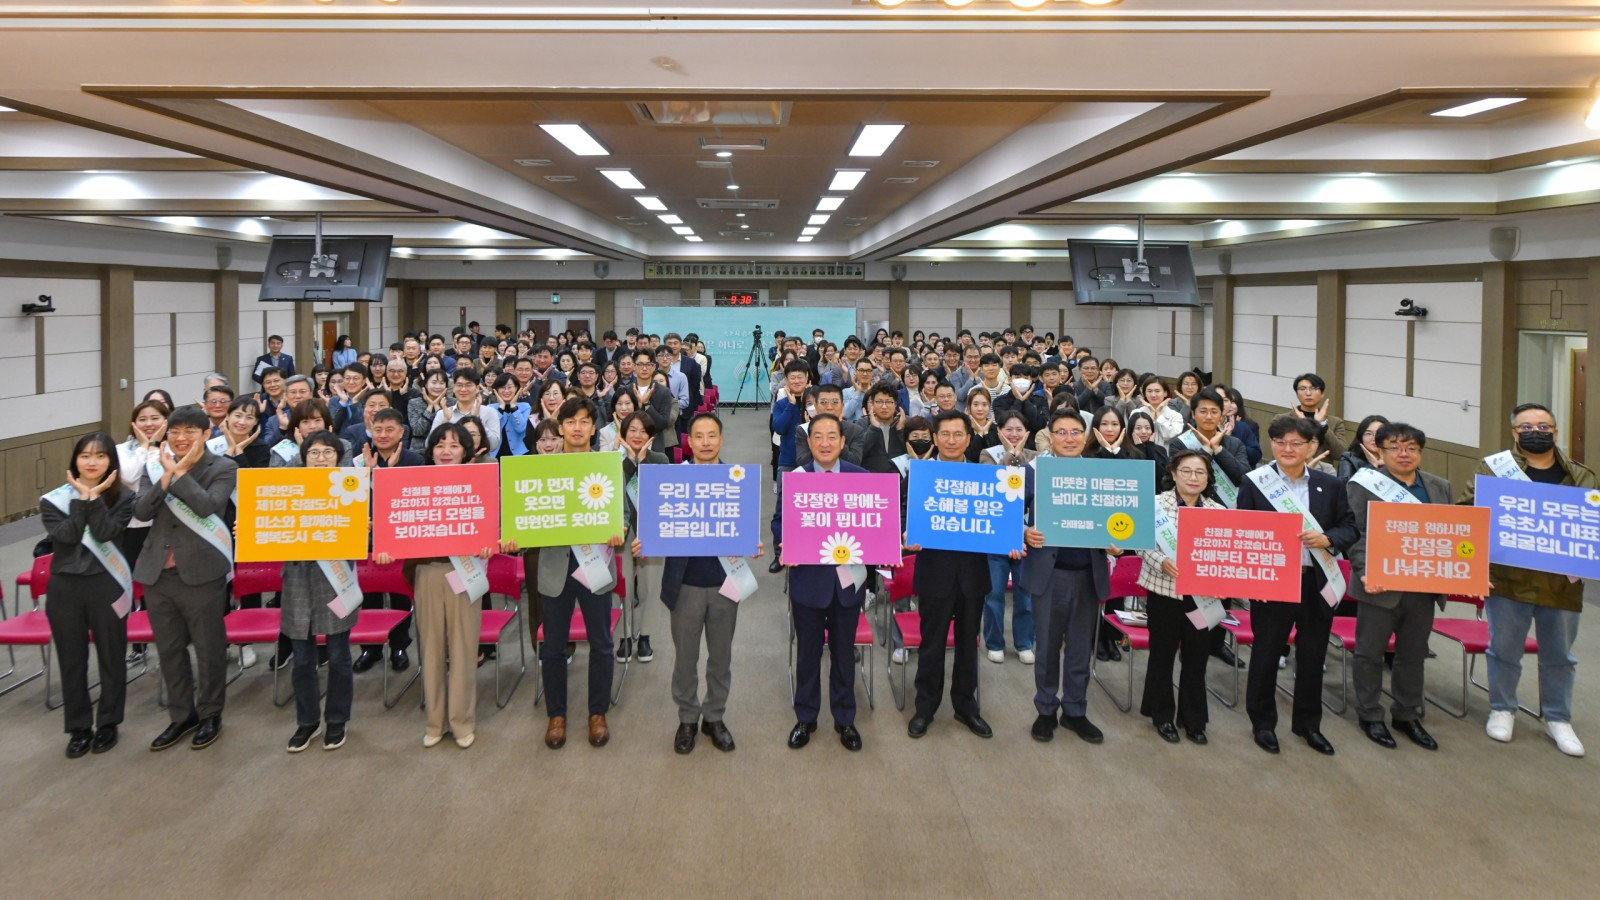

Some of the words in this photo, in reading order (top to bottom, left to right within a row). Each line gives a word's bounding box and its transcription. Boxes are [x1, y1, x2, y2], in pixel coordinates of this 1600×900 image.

[256, 485, 304, 497] 대한민국
[402, 486, 430, 496] 친절을
[434, 485, 471, 495] 후배에게
[515, 480, 543, 494] 내가
[547, 478, 574, 492] 먼저
[659, 483, 689, 498] 우리
[695, 483, 740, 498] 모두는
[934, 479, 994, 497] 친절해서
[1052, 477, 1087, 489] 따뜻한
[1091, 478, 1137, 491] 마음으로
[256, 500, 287, 511] 제1의
[291, 499, 339, 510] 친절도시
[391, 498, 429, 508] 강요하지
[432, 495, 482, 506] 않겠습니다.
[525, 496, 565, 511] 웃으면
[793, 493, 839, 508] 친절한
[844, 494, 888, 509] 말에는
[924, 497, 968, 514] 손해볼
[974, 500, 1003, 516] 일은
[1052, 493, 1087, 505] 날마다
[1092, 494, 1138, 507] 친절하게
[388, 509, 441, 523] 선배부터
[446, 507, 484, 520] 모범을
[659, 502, 704, 518] 속초시
[710, 502, 740, 518] 대표
[1499, 496, 1535, 514] 우리
[1541, 501, 1600, 523] 모두는
[256, 516, 296, 528] 미소와
[300, 515, 350, 528] 함께하는
[515, 514, 567, 530] 민원인도
[572, 512, 609, 527] 웃어요
[801, 512, 830, 527] 꽃이
[836, 512, 881, 527] 핍니다
[931, 515, 994, 534] 없습니다.
[1155, 516, 1169, 529] 초시
[1499, 514, 1554, 536] 속초시
[1561, 521, 1600, 541] 대표
[395, 522, 478, 538] 보이겠습니다.
[659, 522, 739, 537] 얼굴입니다.
[1205, 528, 1232, 537] 친절을
[1236, 529, 1274, 540] 후배에게
[1386, 520, 1419, 534] 친절을
[1425, 522, 1470, 536] 원하시면
[256, 531, 307, 544] 행복도시
[312, 530, 336, 542] 속초
[1194, 538, 1230, 548] 강요하지
[1234, 540, 1283, 551] 않겠습니다.
[1401, 537, 1453, 557] 친절을
[1499, 531, 1600, 560] 얼굴입니다.
[1191, 549, 1242, 563] 선배부터
[1246, 552, 1285, 566] 모범을
[1196, 564, 1278, 581] 보이겠습니다.
[1383, 558, 1470, 579] 나눠주세요
